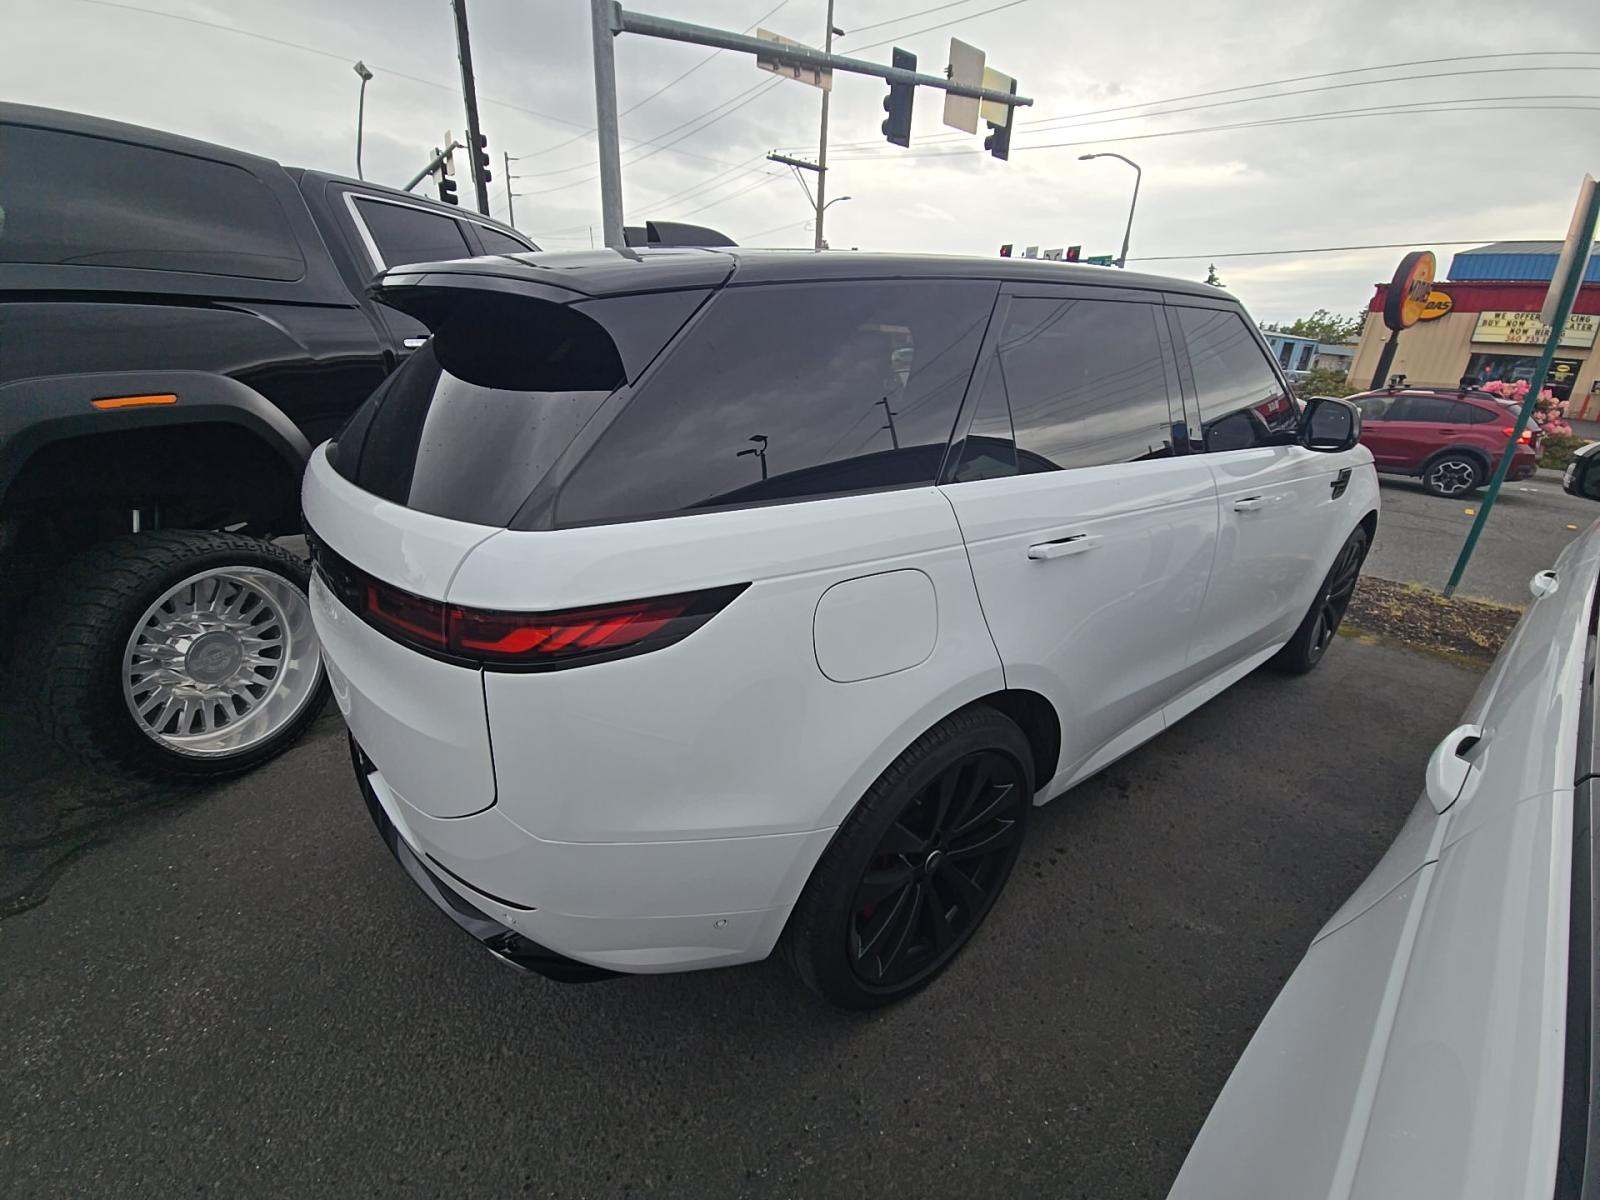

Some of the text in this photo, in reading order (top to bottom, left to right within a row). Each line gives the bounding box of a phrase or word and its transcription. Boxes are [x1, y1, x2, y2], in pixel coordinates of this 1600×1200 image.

[1424, 301, 1450, 310] DAS
[1494, 312, 1541, 321] WE OFFER
[1482, 319, 1499, 327] BUY
[1509, 328, 1566, 337] NOW HIRG
